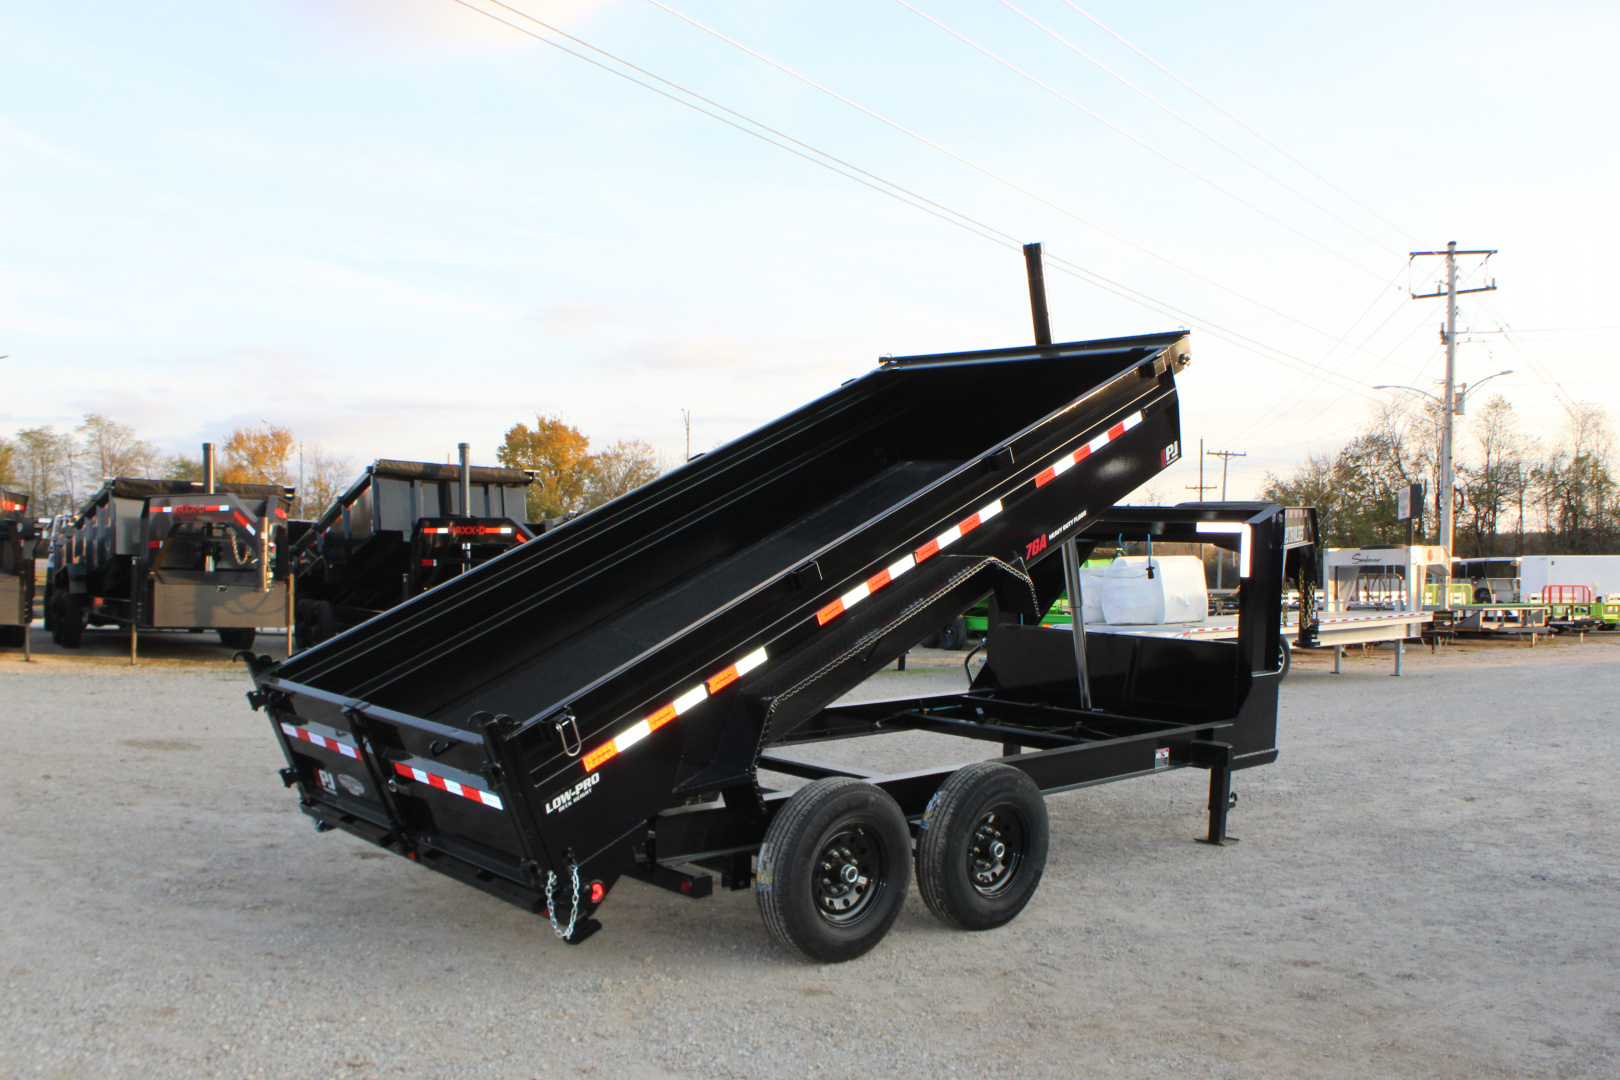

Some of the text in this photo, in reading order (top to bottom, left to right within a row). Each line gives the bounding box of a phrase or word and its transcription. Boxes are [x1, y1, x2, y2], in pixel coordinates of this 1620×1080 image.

[1165, 440, 1179, 462] PJ
[1026, 509, 1088, 560] 7GA HEAVY DUTY FLOOR
[318, 769, 336, 791] PJ
[545, 772, 600, 815] LOW-PRO
[558, 800, 573, 813] DECK
